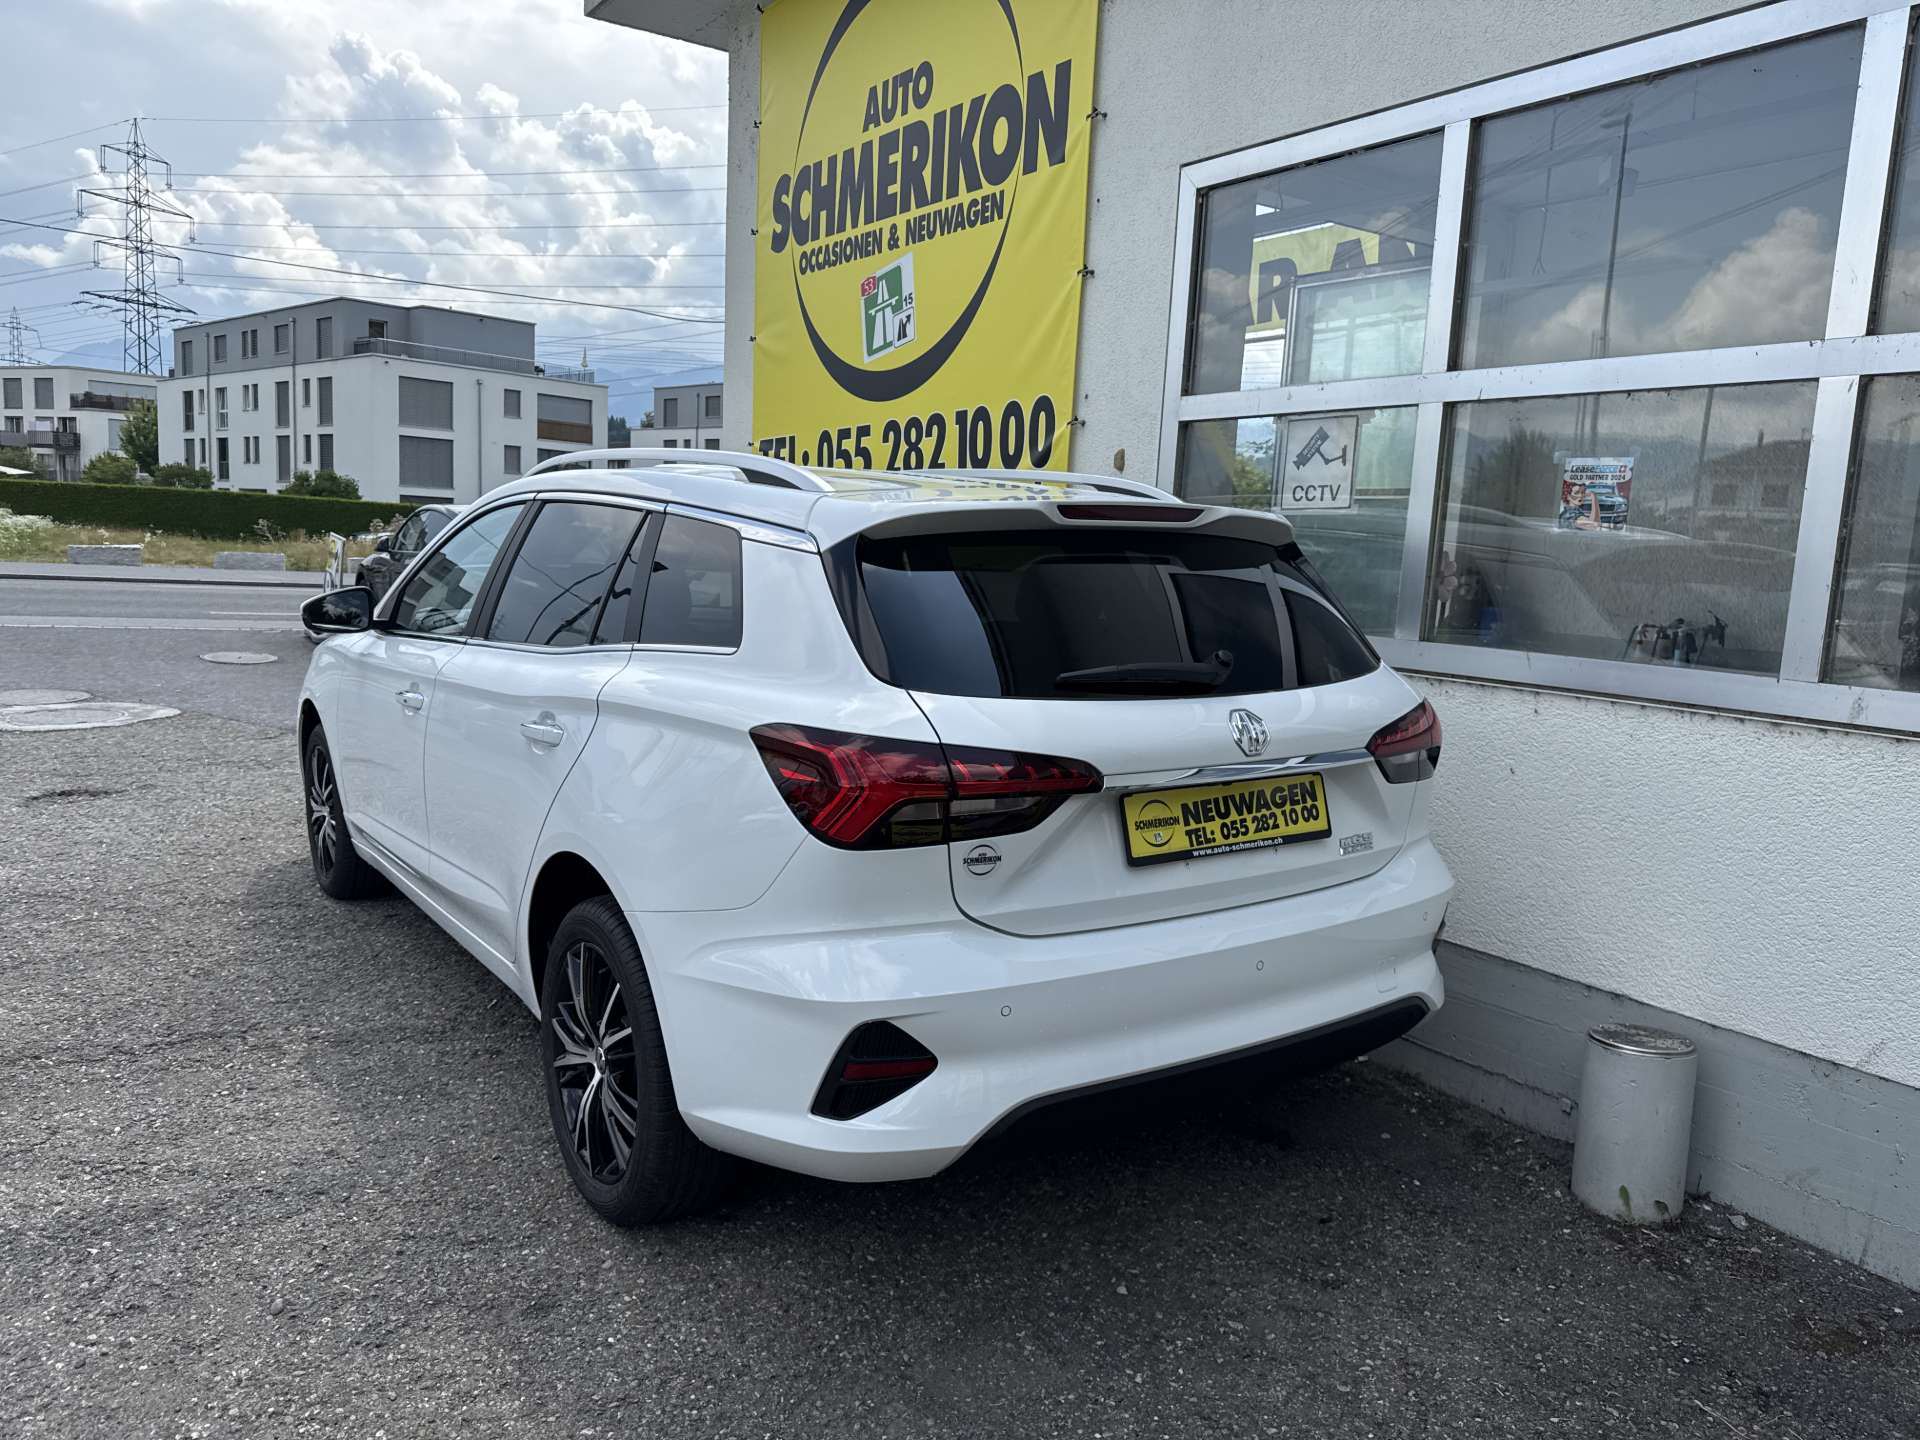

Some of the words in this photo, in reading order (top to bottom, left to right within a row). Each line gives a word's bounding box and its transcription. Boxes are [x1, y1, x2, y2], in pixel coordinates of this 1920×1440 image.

[862, 61, 934, 133] AUTO
[771, 59, 1072, 253] SCHMERIKON
[800, 227, 883, 275] OCCASIONEN
[887, 223, 900, 250] &
[905, 190, 1005, 246] NEUWAGEN
[863, 278, 874, 295] 53
[904, 292, 913, 307] 15
[817, 424, 872, 470] 055
[882, 412, 946, 471] 282
[955, 405, 992, 470] 10
[1000, 394, 1055, 470] 00
[1292, 484, 1341, 502] CCTV
[1181, 780, 1318, 827] NEUWAGEN
[1135, 816, 1180, 831] SCHMERIKON
[1185, 826, 1217, 848] TEL:
[1220, 818, 1250, 840] 055
[1251, 812, 1280, 834] 282
[1281, 808, 1299, 827] 10
[1300, 804, 1320, 823] 00
[963, 855, 1002, 865] SCHMERIKON
[1192, 837, 1283, 857] www.auto-schmerikon.ch
